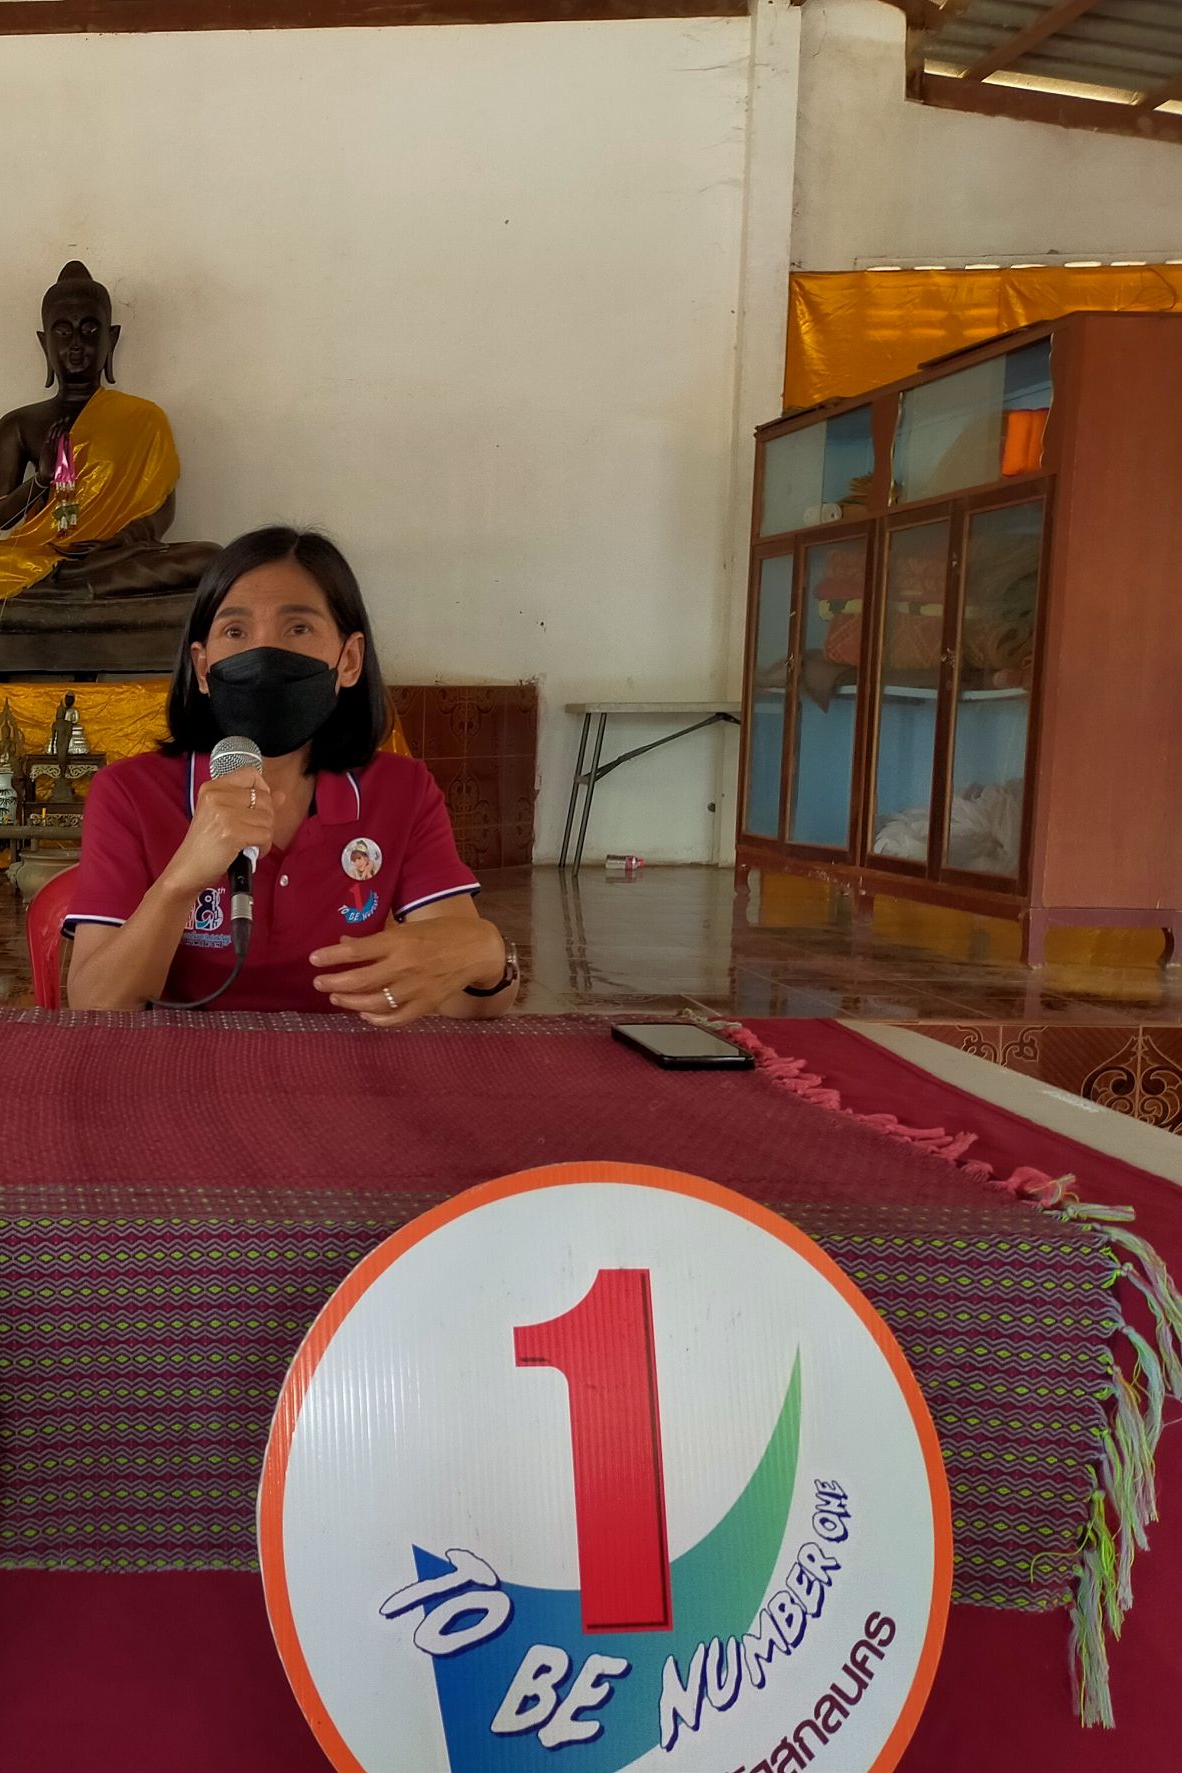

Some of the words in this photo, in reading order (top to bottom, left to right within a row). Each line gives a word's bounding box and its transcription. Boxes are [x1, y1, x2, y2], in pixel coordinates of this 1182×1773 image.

[513, 1268, 673, 1635] 1
[379, 1548, 515, 1659] TO
[490, 1643, 633, 1751] BE
[659, 1541, 842, 1753] NUMBER
[812, 1478, 852, 1544] ONE
